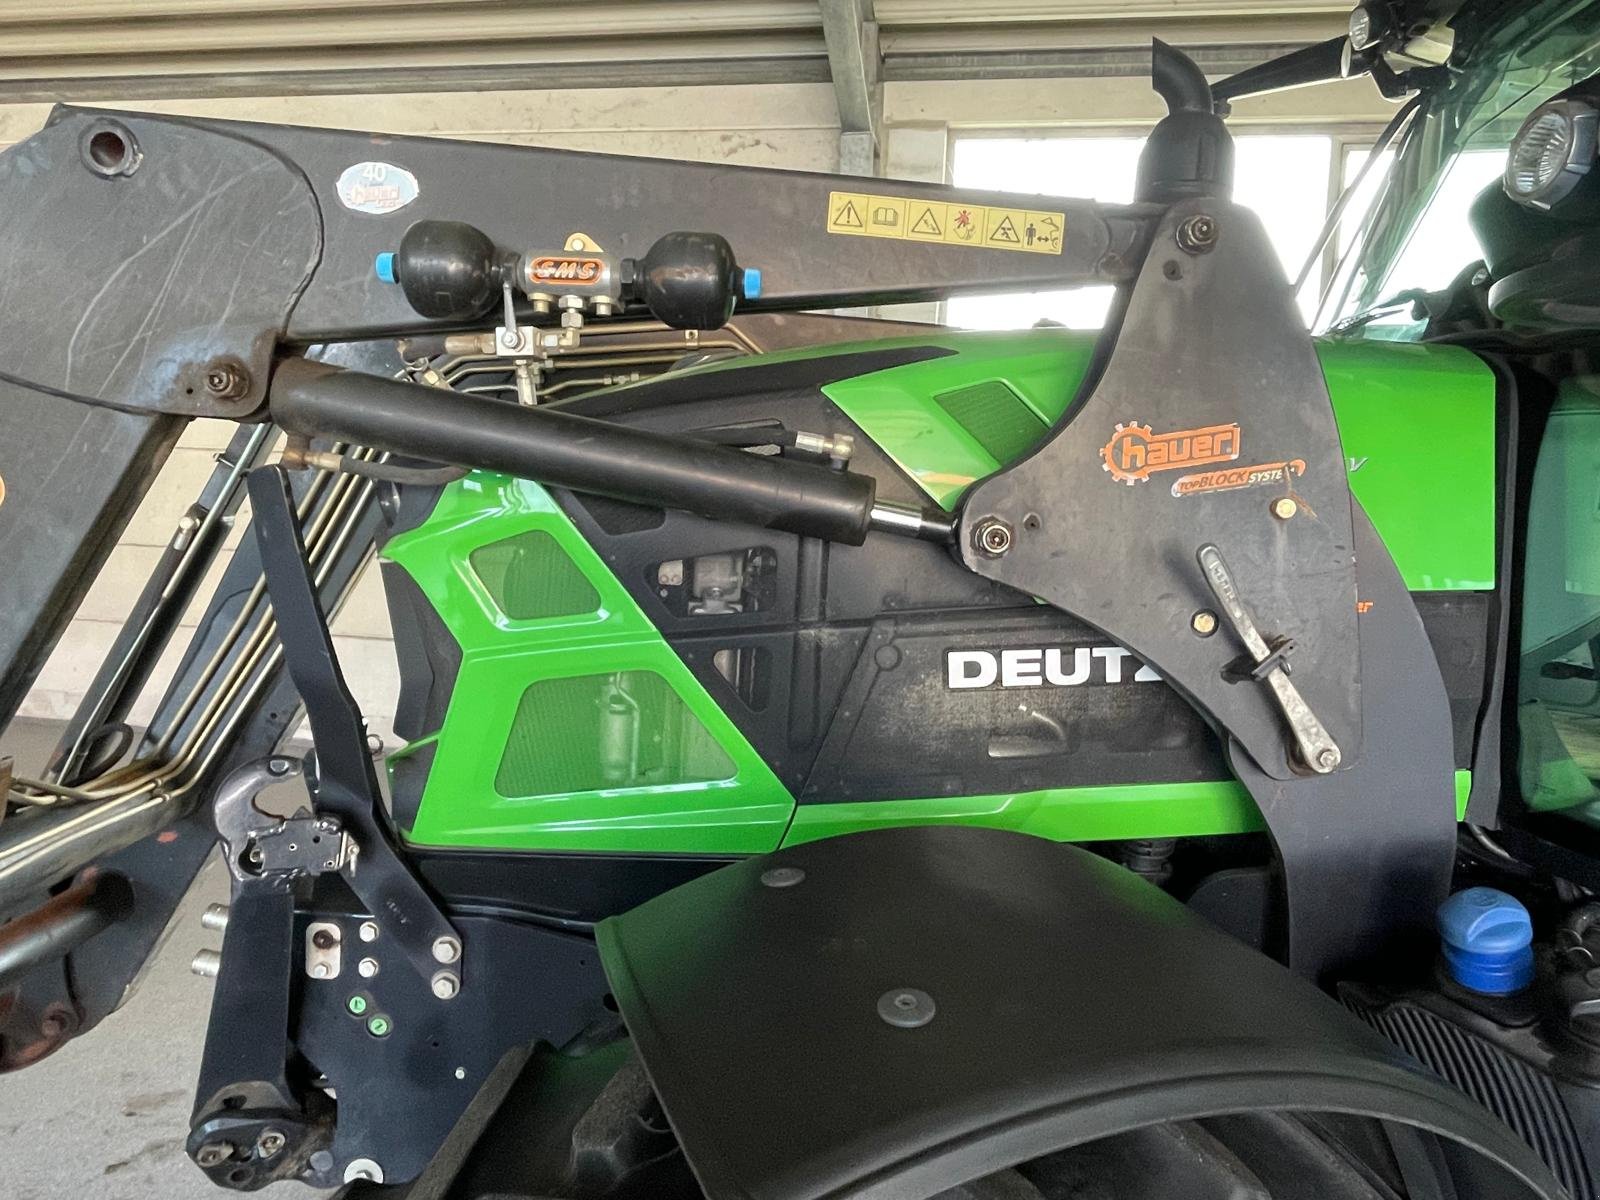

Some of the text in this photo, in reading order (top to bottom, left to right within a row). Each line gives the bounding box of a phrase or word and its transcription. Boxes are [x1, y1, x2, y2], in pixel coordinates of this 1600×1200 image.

[362, 165, 386, 182] 40
[1122, 432, 1232, 469] hauer
[1249, 467, 1295, 484] SYSTE
